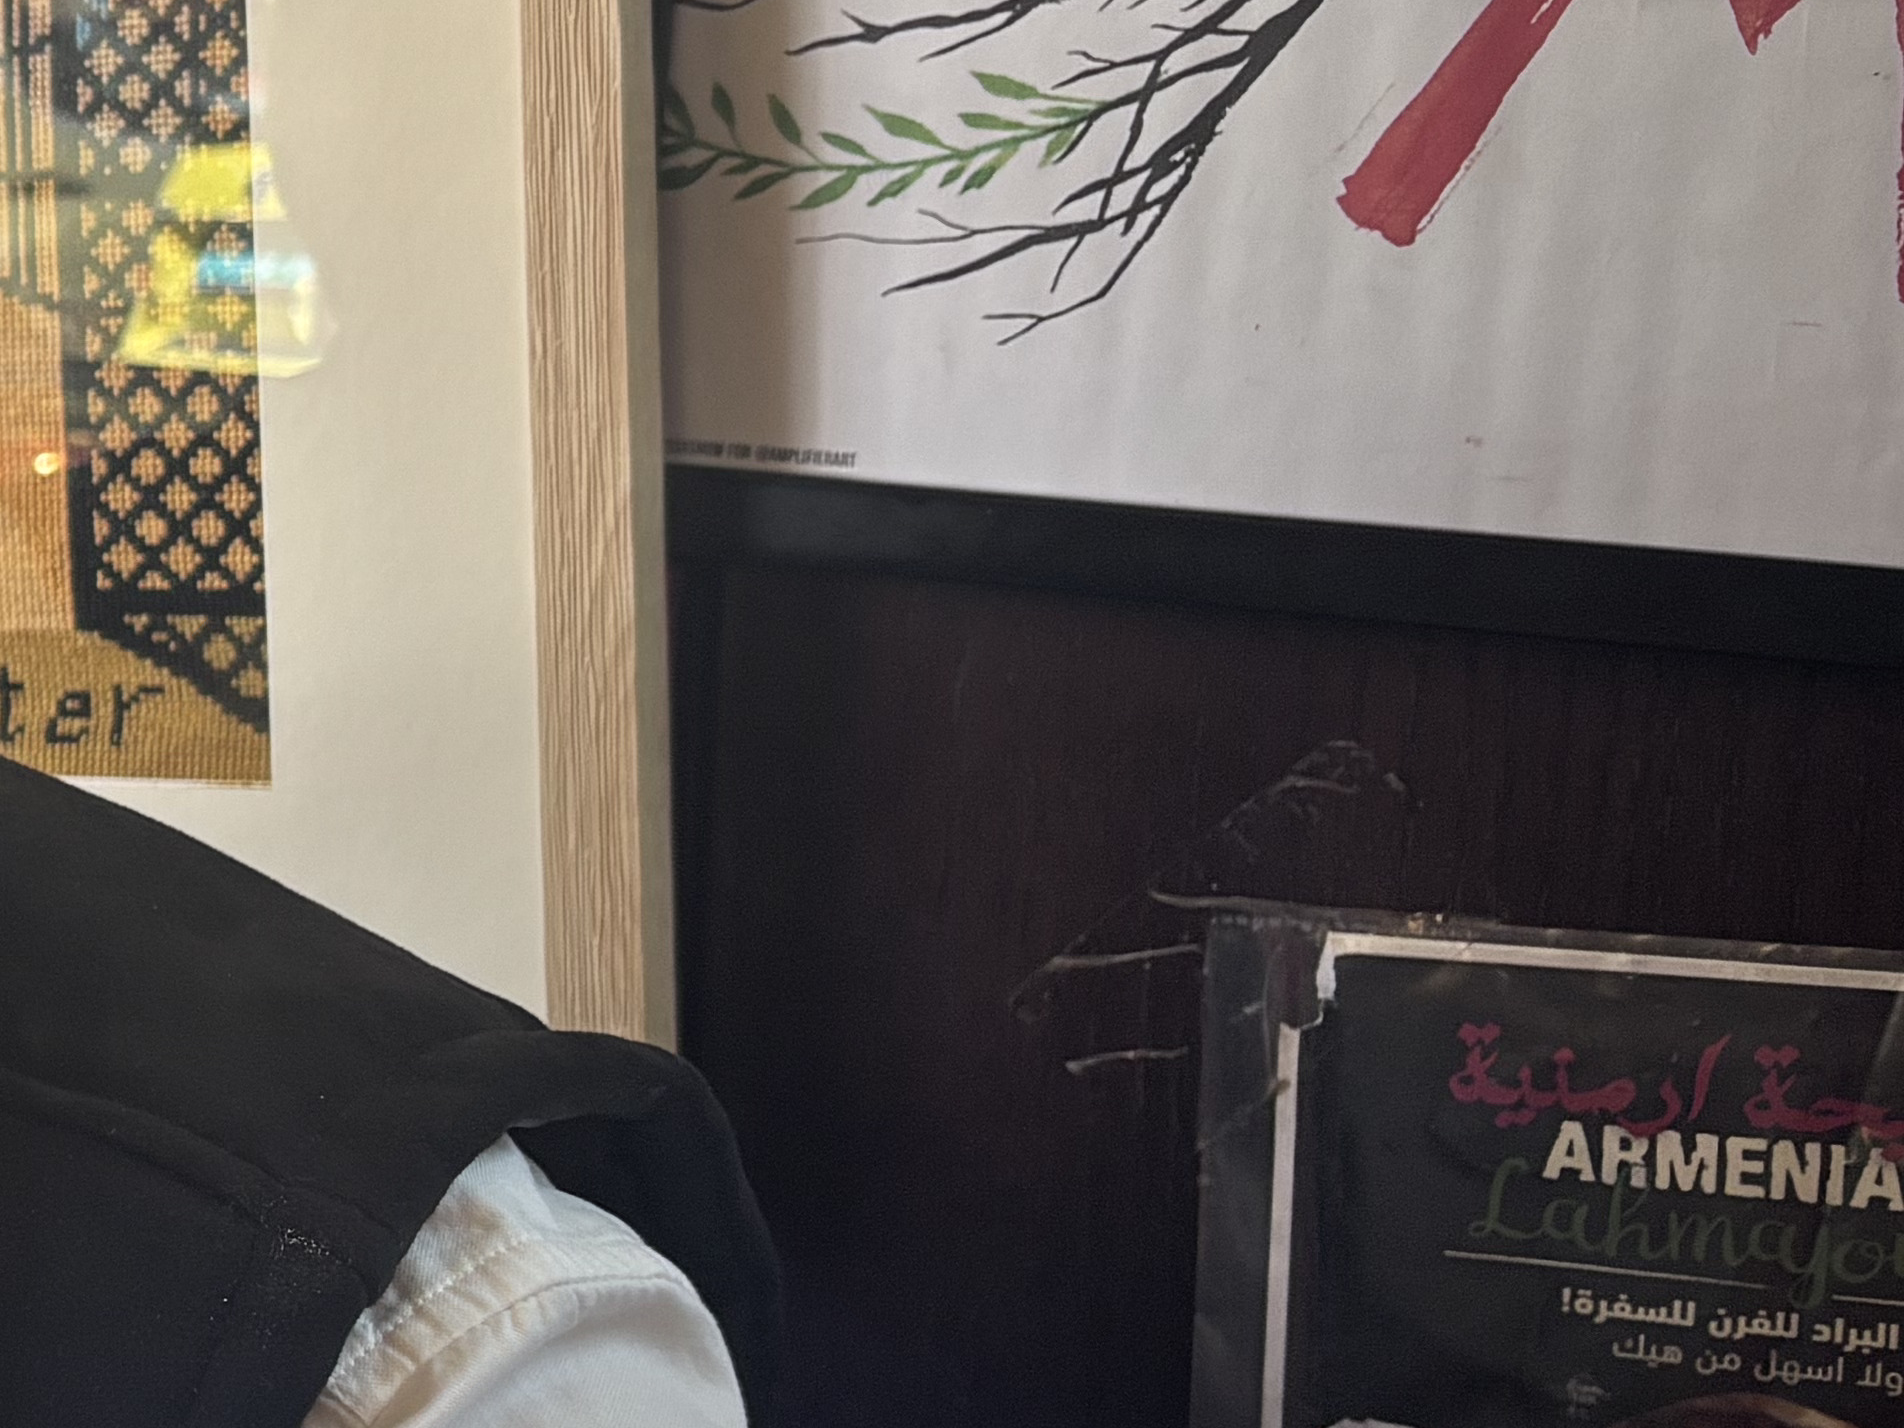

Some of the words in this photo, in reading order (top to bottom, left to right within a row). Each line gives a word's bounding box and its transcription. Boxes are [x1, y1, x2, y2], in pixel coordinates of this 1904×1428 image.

[1708, 1308, 1800, 1340] للفرن
[1812, 1318, 1900, 1354] البراد
[1612, 1334, 1683, 1370] هيك
[1695, 1349, 1742, 1374] من
